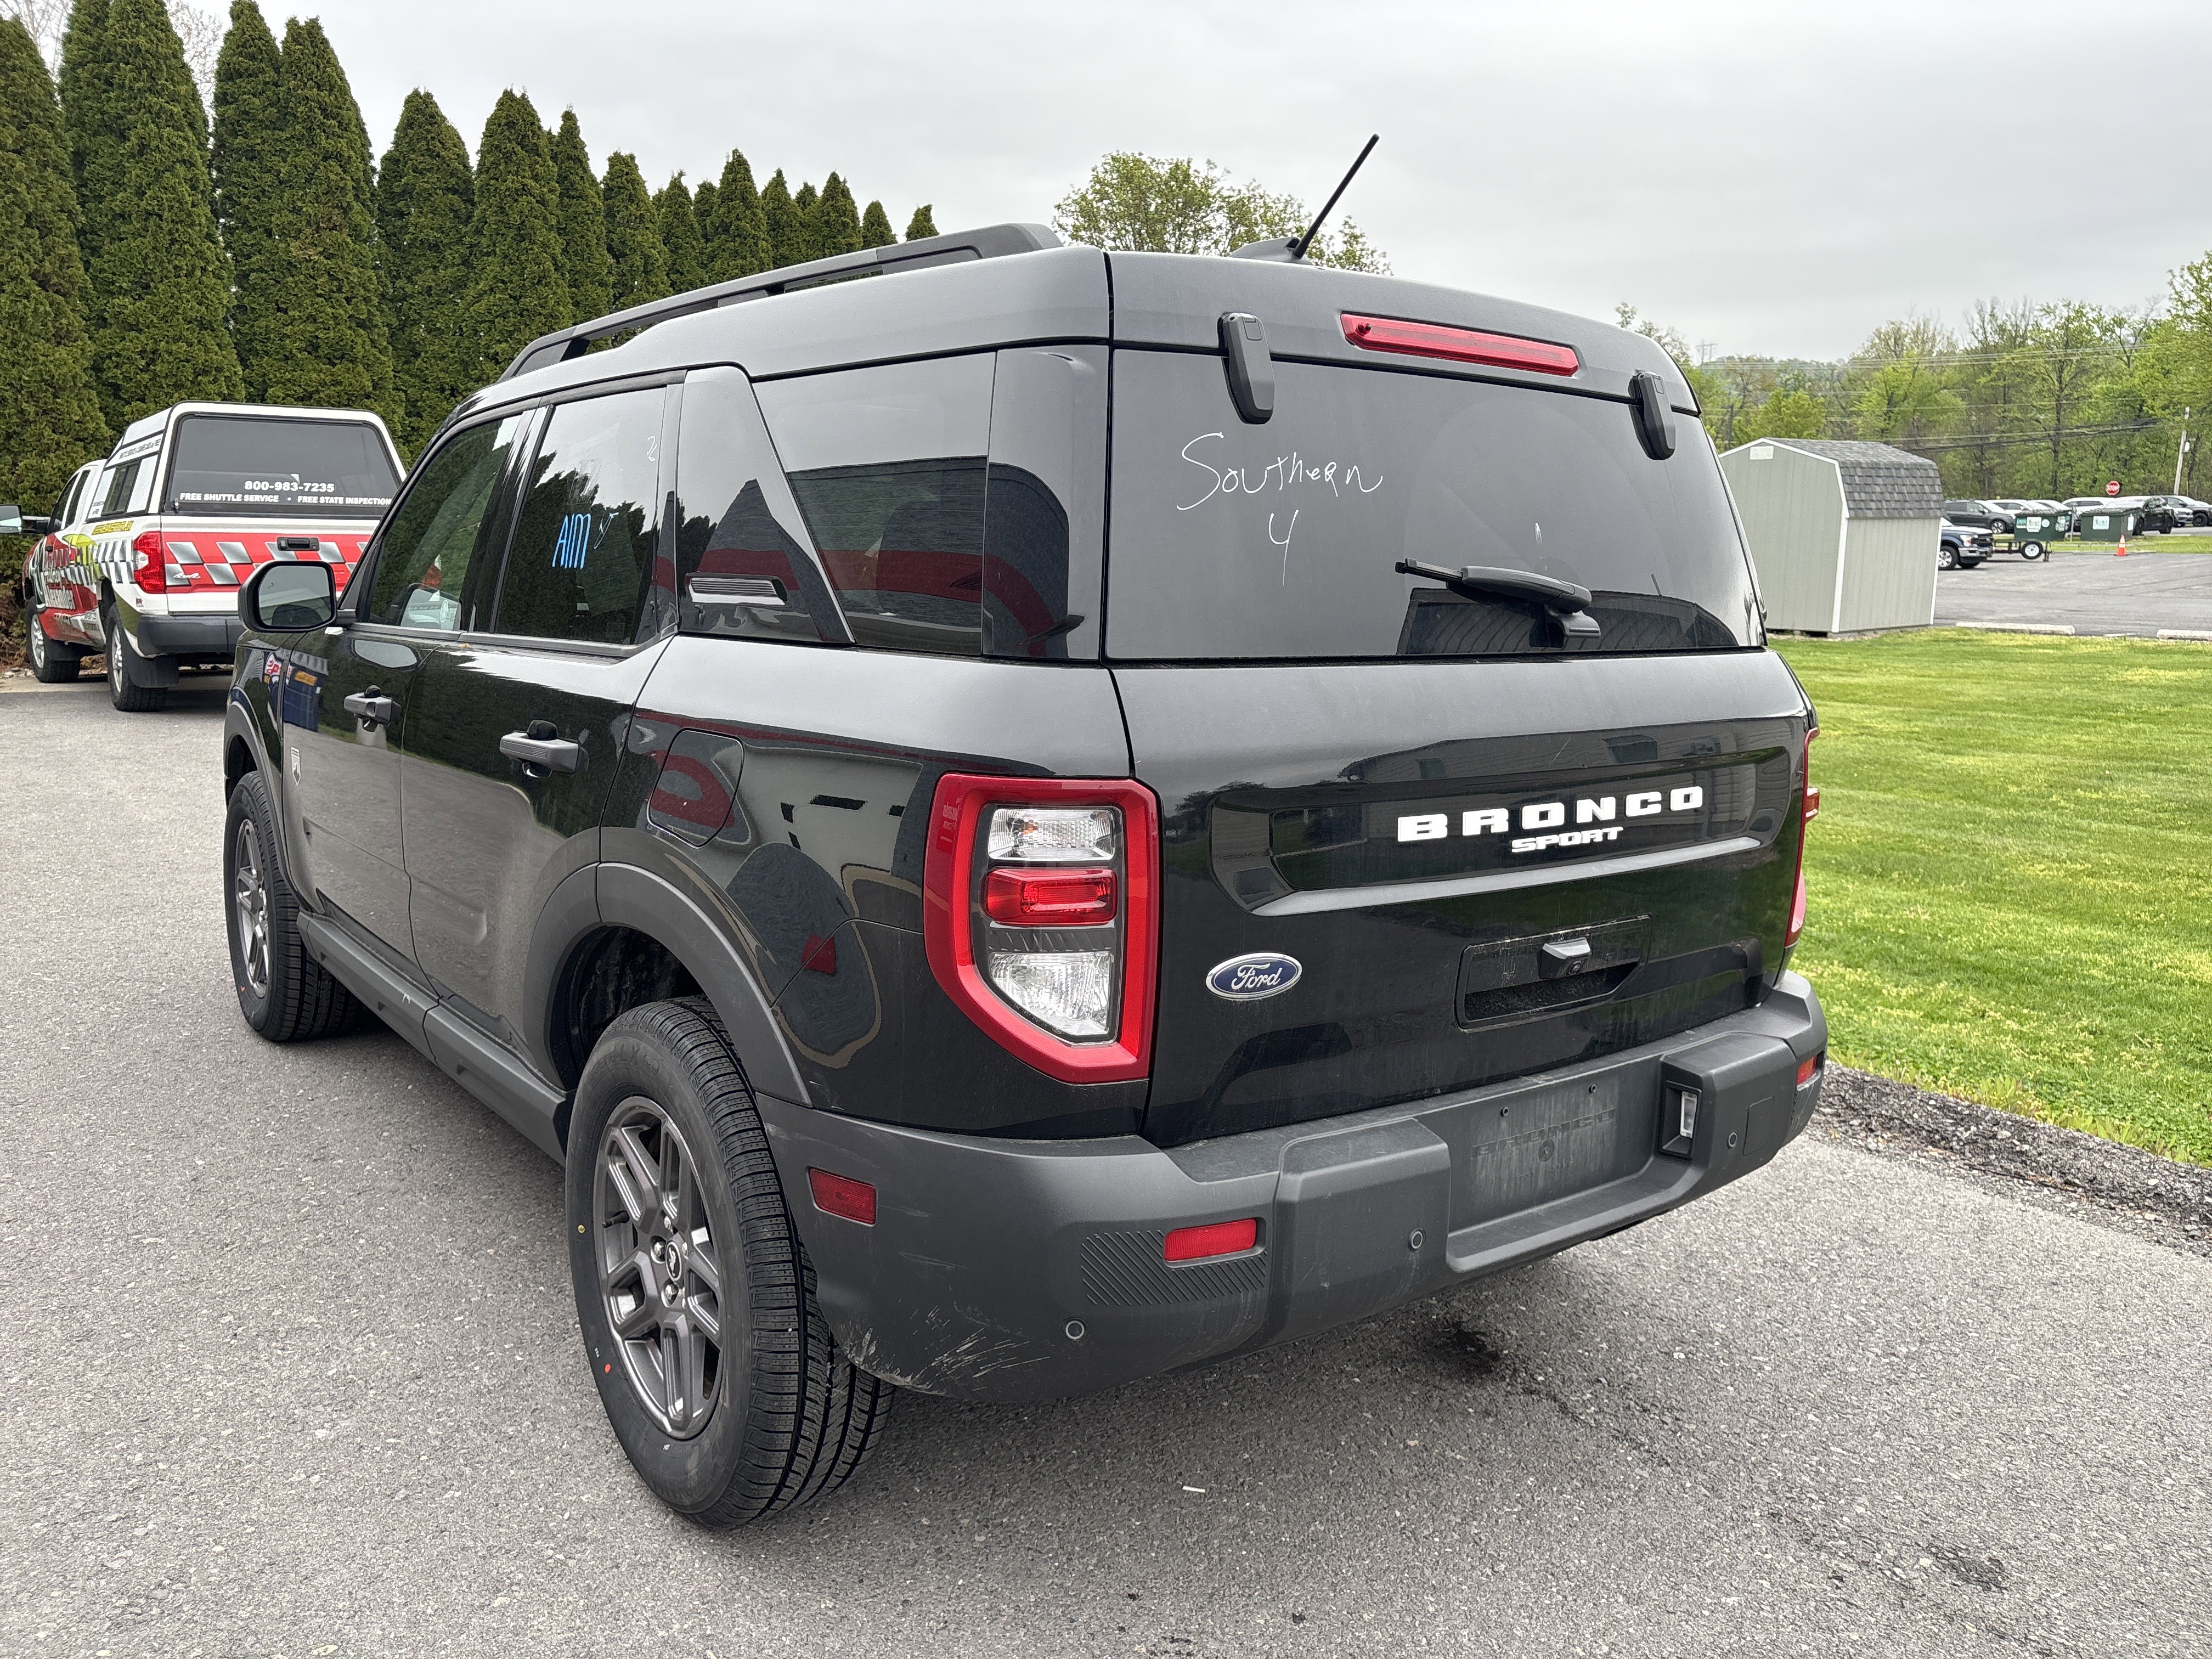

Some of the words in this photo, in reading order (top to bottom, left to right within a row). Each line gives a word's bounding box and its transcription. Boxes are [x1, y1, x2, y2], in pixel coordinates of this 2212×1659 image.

[180, 493, 202, 501] FREE
[204, 494, 242, 502] SHUTTLE
[244, 495, 279, 503] SERVICE
[319, 496, 345, 505] STATE
[345, 497, 393, 505] INSPECTION
[244, 481, 335, 493] 800-983-7235
[552, 513, 591, 569] AIM
[1268, 509, 1299, 586] 4
[1397, 786, 1703, 843] BRONCO
[1511, 826, 1624, 853] SPORT
[1231, 963, 1283, 990] Ford
